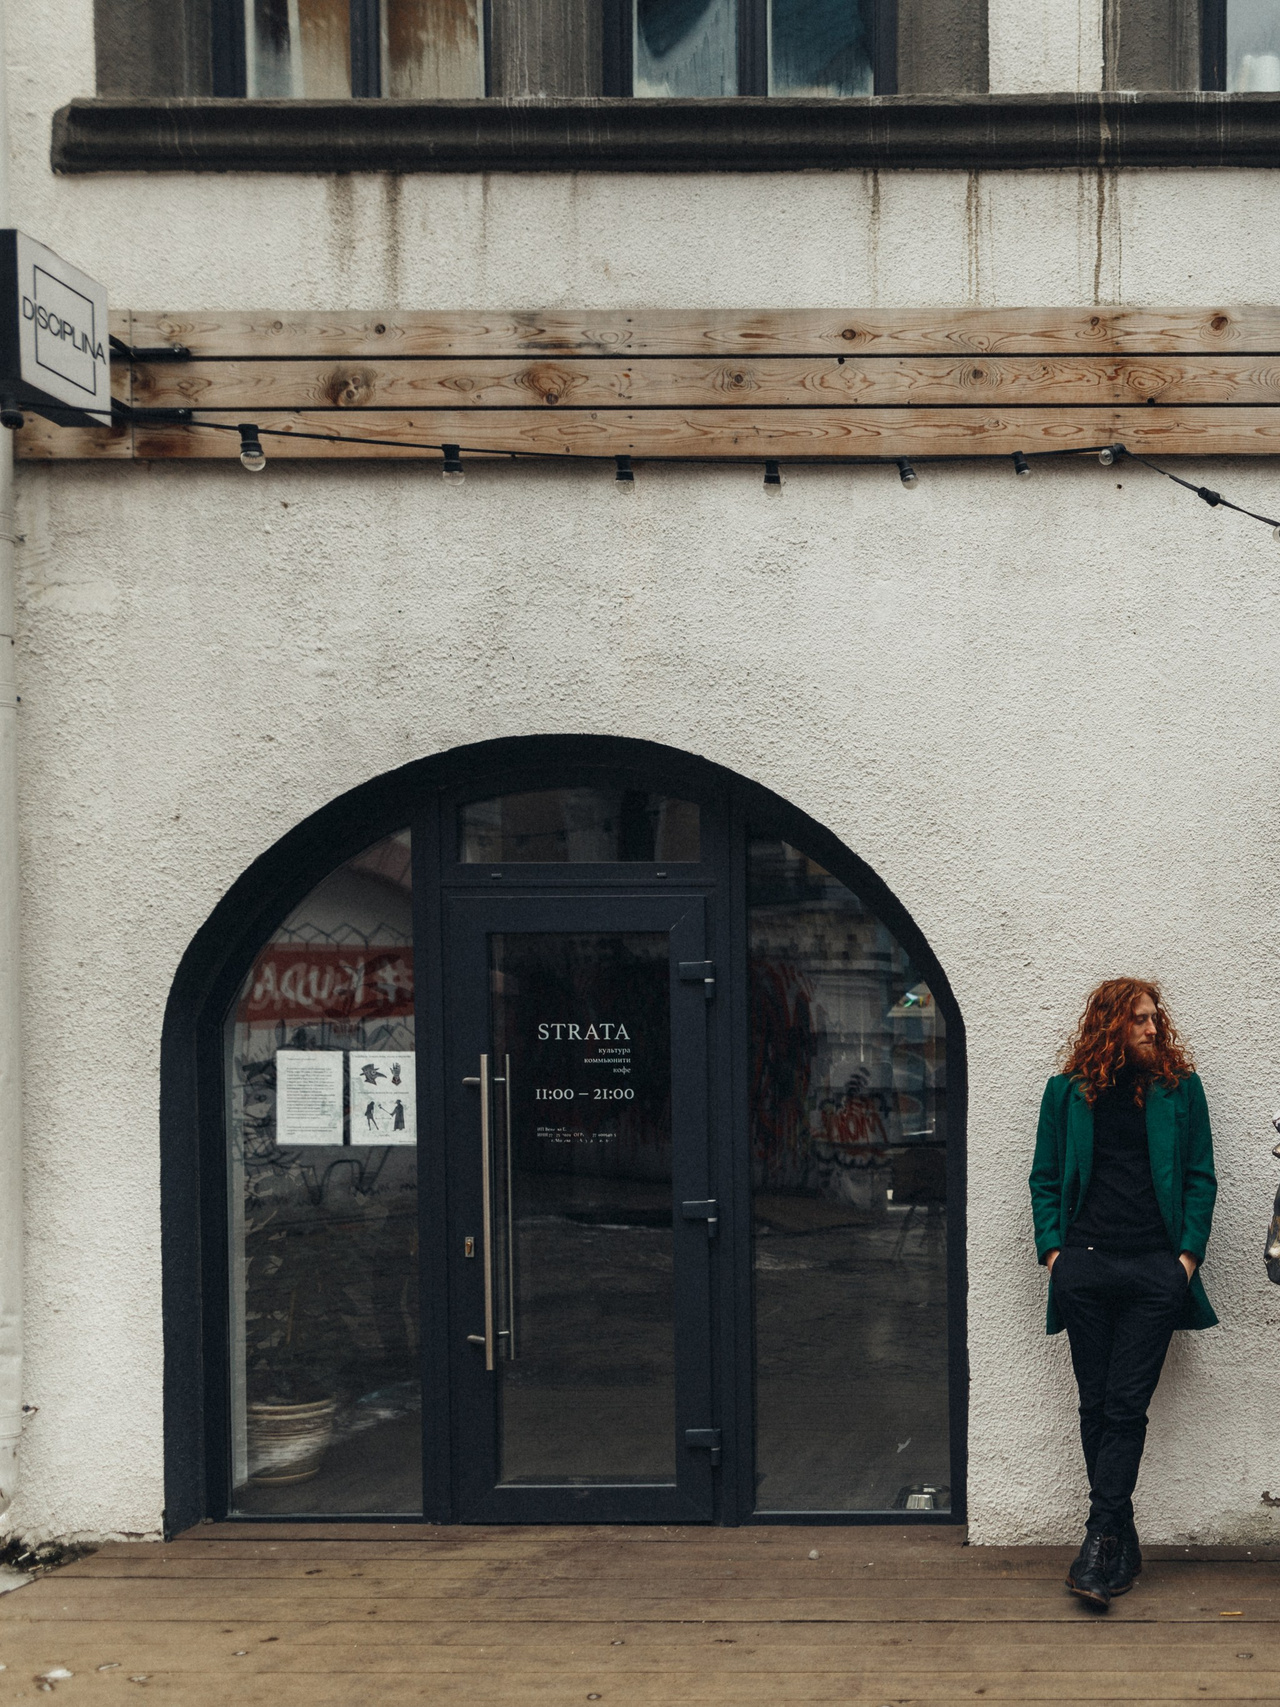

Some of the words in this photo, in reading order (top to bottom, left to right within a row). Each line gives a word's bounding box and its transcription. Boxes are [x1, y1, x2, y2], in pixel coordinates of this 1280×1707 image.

[23, 296, 106, 365] DISCIPLINA
[538, 1023, 630, 1040] STRATA
[613, 1066, 631, 1074] кофе
[536, 1088, 574, 1100] 11:00
[593, 1088, 634, 1100] 21:00
